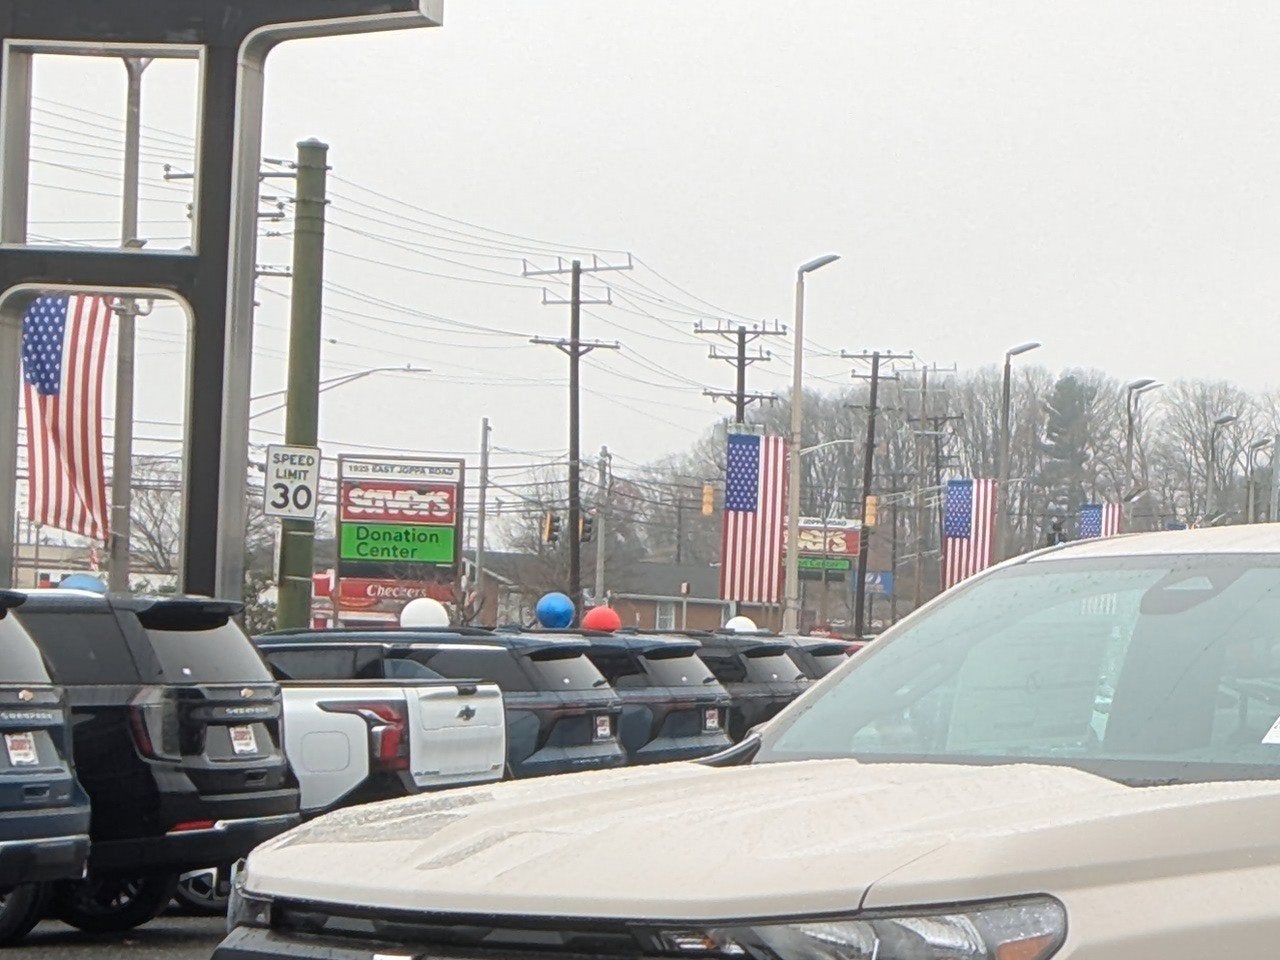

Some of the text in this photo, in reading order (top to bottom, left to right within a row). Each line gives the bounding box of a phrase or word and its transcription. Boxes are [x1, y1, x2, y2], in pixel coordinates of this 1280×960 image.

[273, 453, 315, 466] SPEED
[276, 468, 309, 481] LIMIT
[371, 465, 395, 474] EAST
[270, 482, 312, 510] 30
[355, 525, 440, 544] Donation
[355, 542, 419, 560] Center
[366, 584, 427, 597] Checers
